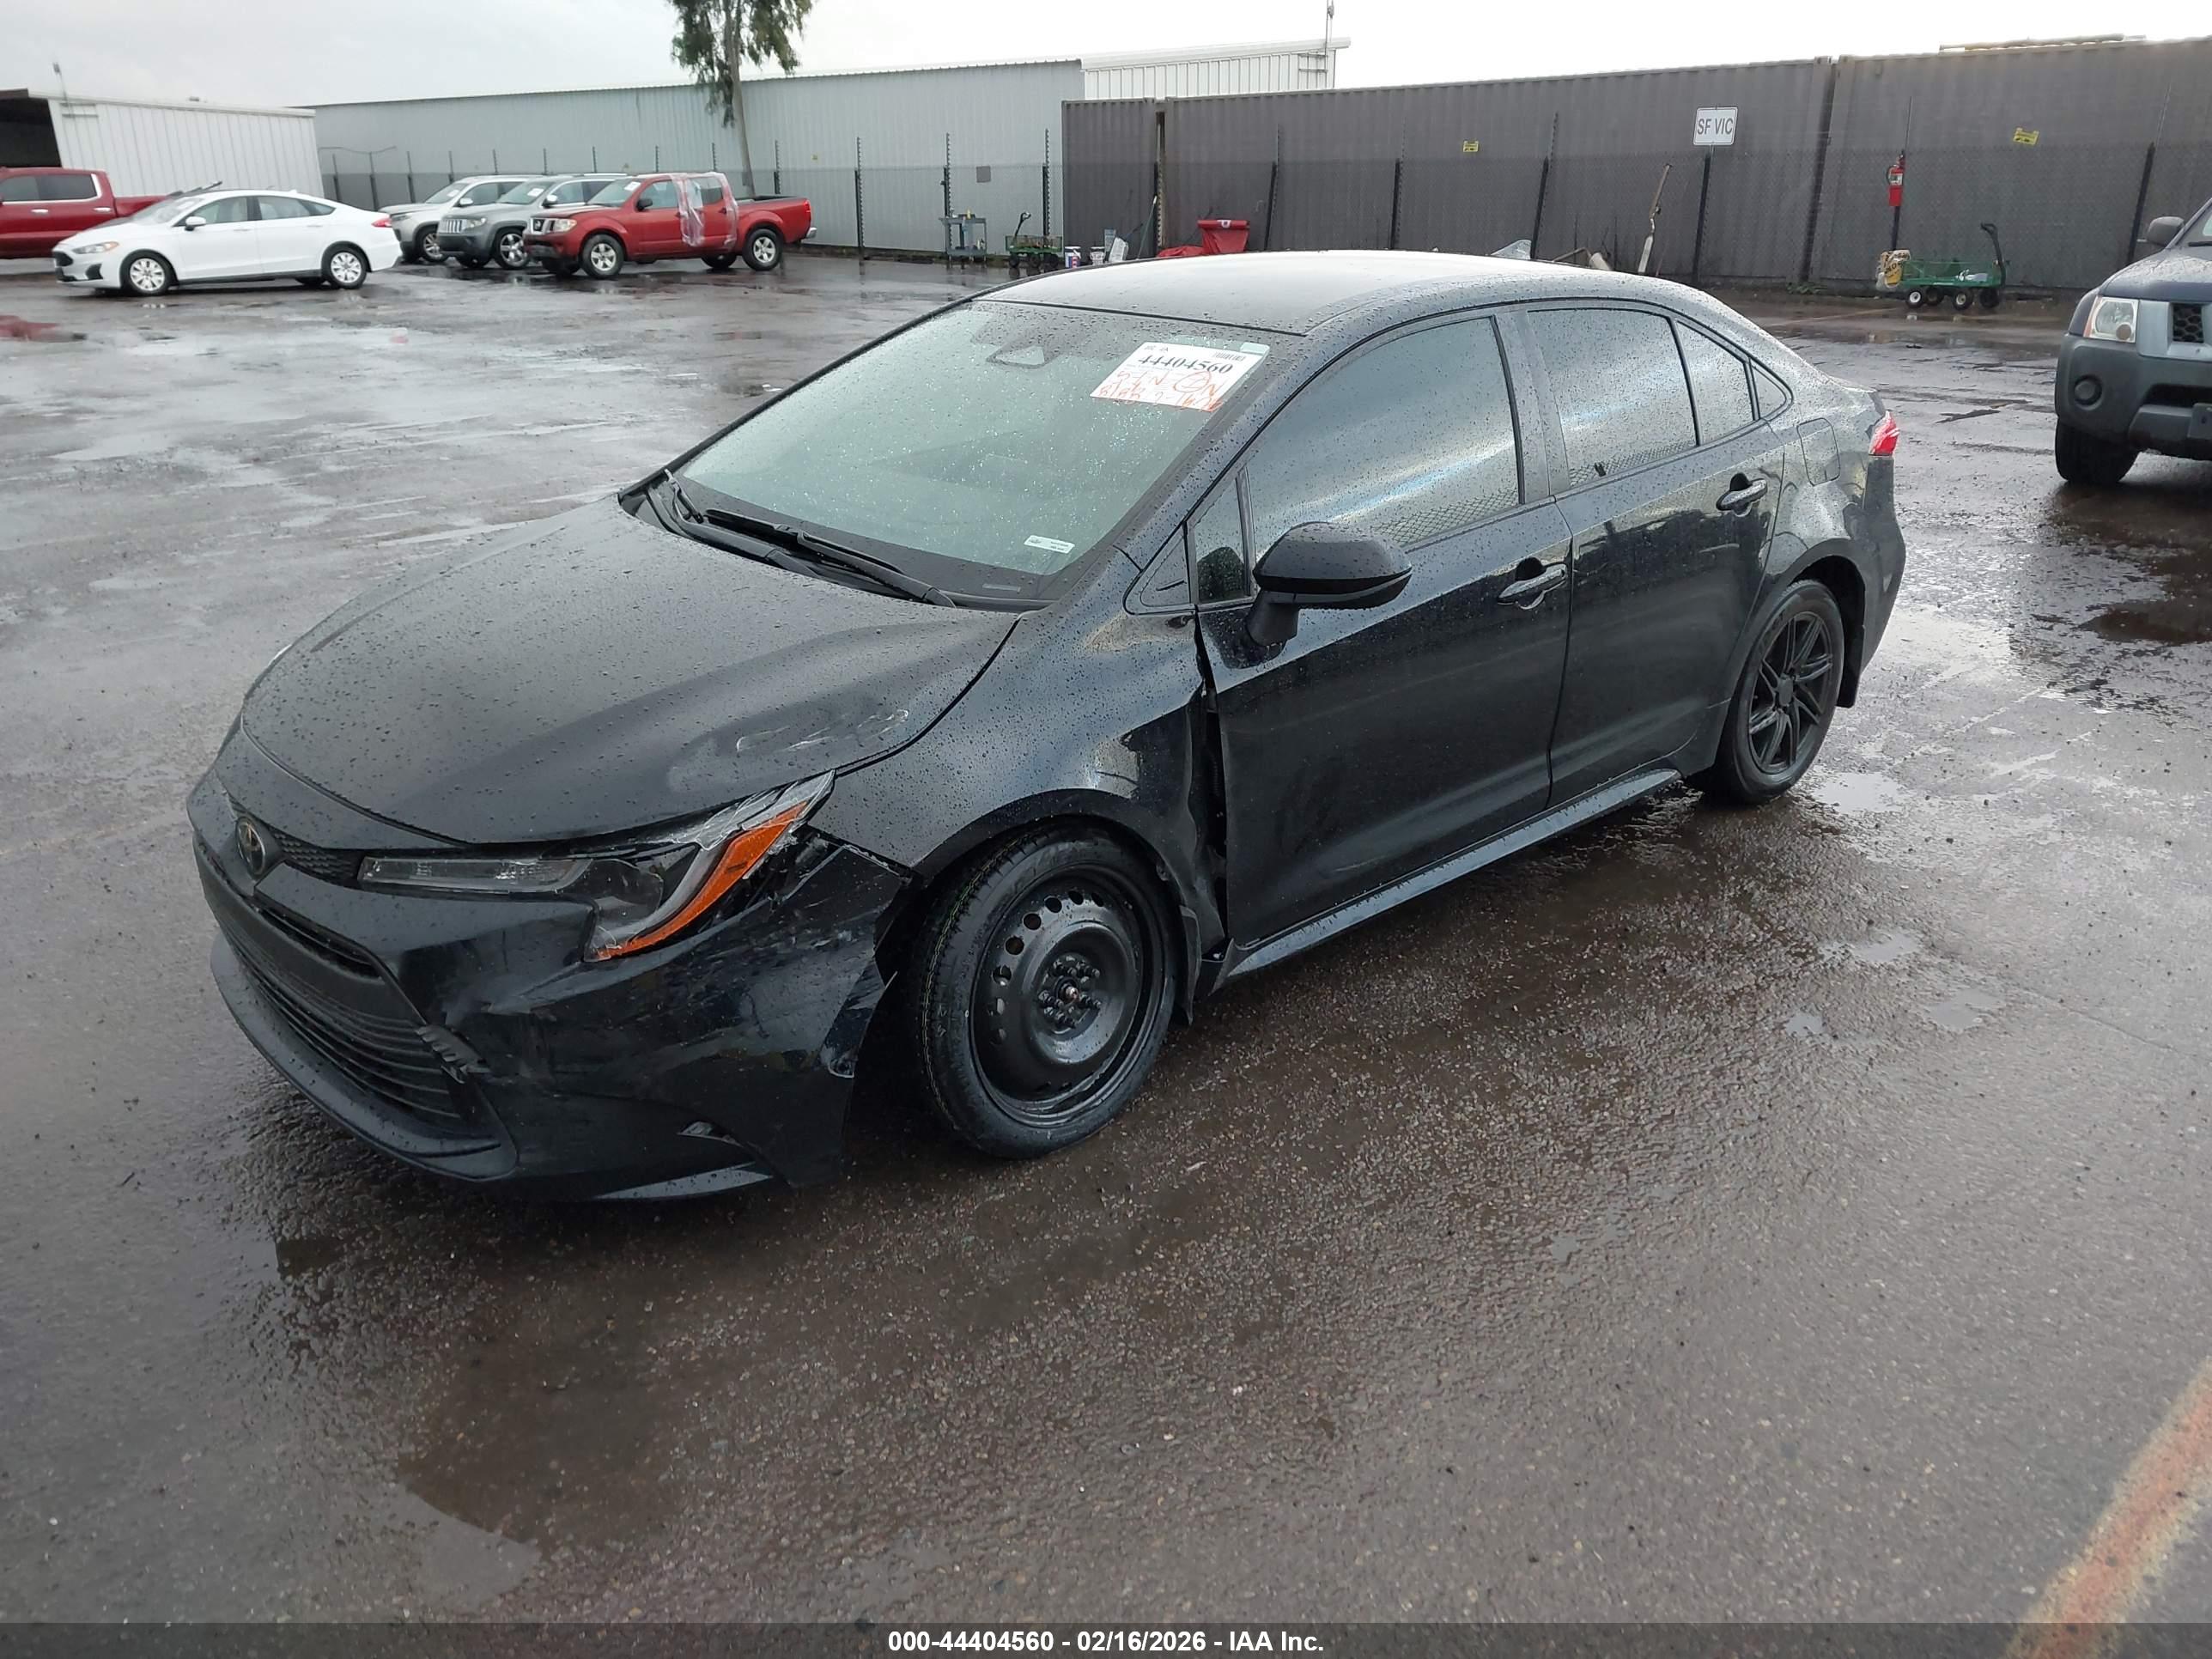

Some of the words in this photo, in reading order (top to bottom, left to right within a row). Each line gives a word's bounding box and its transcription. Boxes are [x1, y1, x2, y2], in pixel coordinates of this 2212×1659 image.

[1697, 118, 1711, 135] SF
[1715, 118, 1734, 135] VIC
[1139, 355, 1233, 374] 44404560
